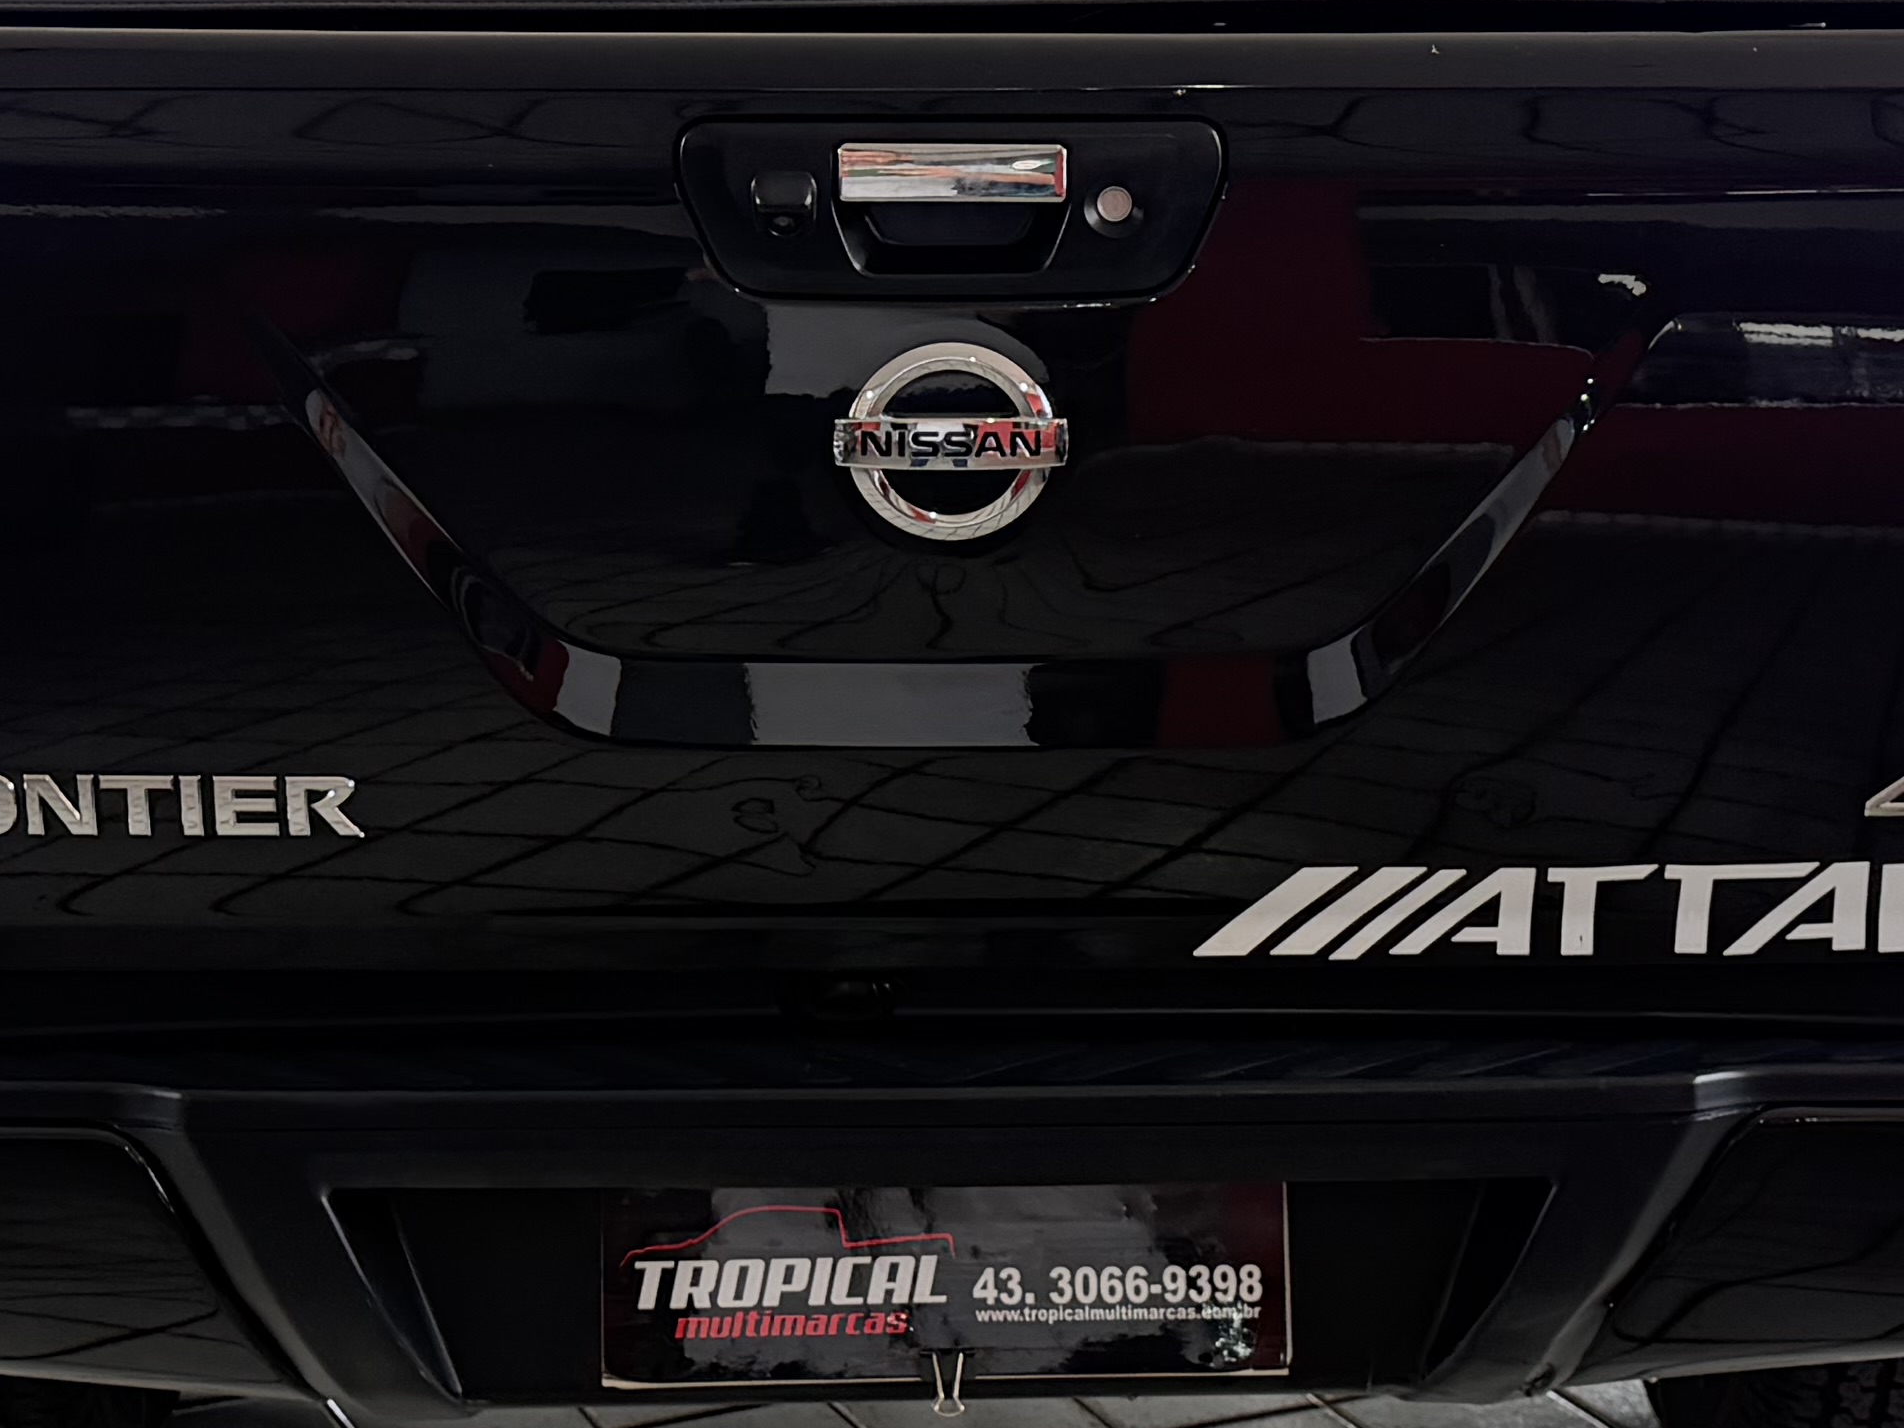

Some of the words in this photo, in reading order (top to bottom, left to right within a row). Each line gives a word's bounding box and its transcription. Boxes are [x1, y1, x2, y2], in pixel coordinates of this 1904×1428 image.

[859, 429, 1042, 459] NISSAN
[633, 1254, 948, 1311] TROPICAL
[972, 1266, 1036, 1306] 43.
[1049, 1263, 1264, 1305] 3066-9398
[674, 1309, 910, 1340] multimarcas
[975, 1303, 1262, 1325] www.tropicalmultimarcas.com.br
